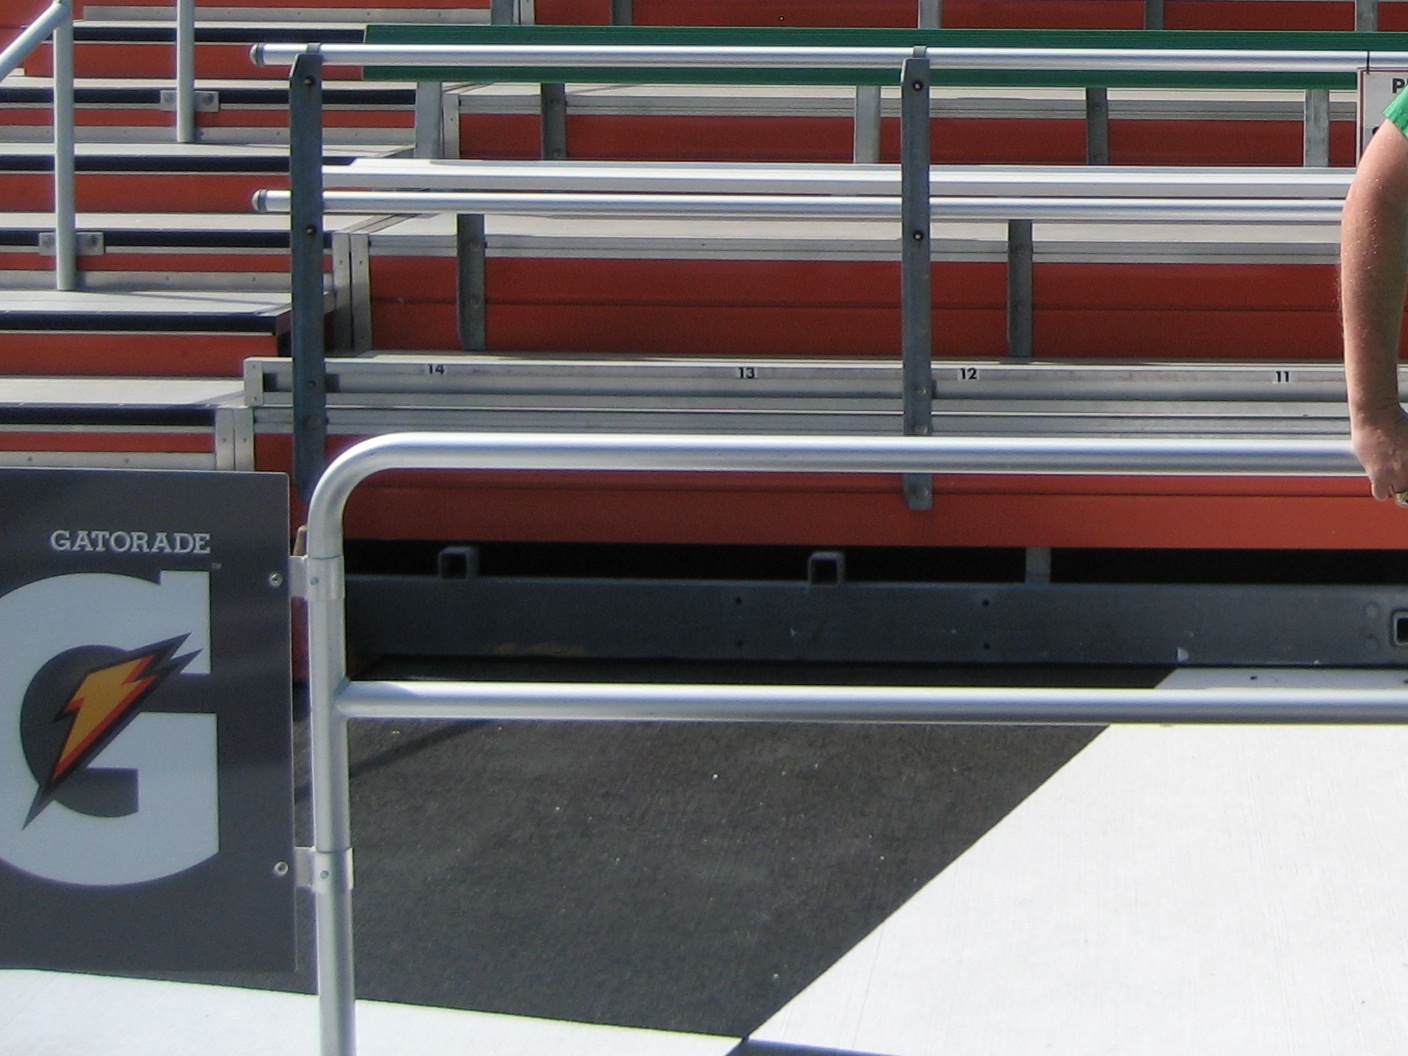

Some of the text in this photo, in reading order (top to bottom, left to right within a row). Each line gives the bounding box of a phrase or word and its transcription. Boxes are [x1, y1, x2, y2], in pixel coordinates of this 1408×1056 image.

[429, 363, 445, 375] 14
[739, 366, 755, 379] 13
[960, 367, 977, 380] 12
[1276, 370, 1289, 382] 11
[50, 529, 211, 554] GATORADE
[0, 570, 219, 887] G
